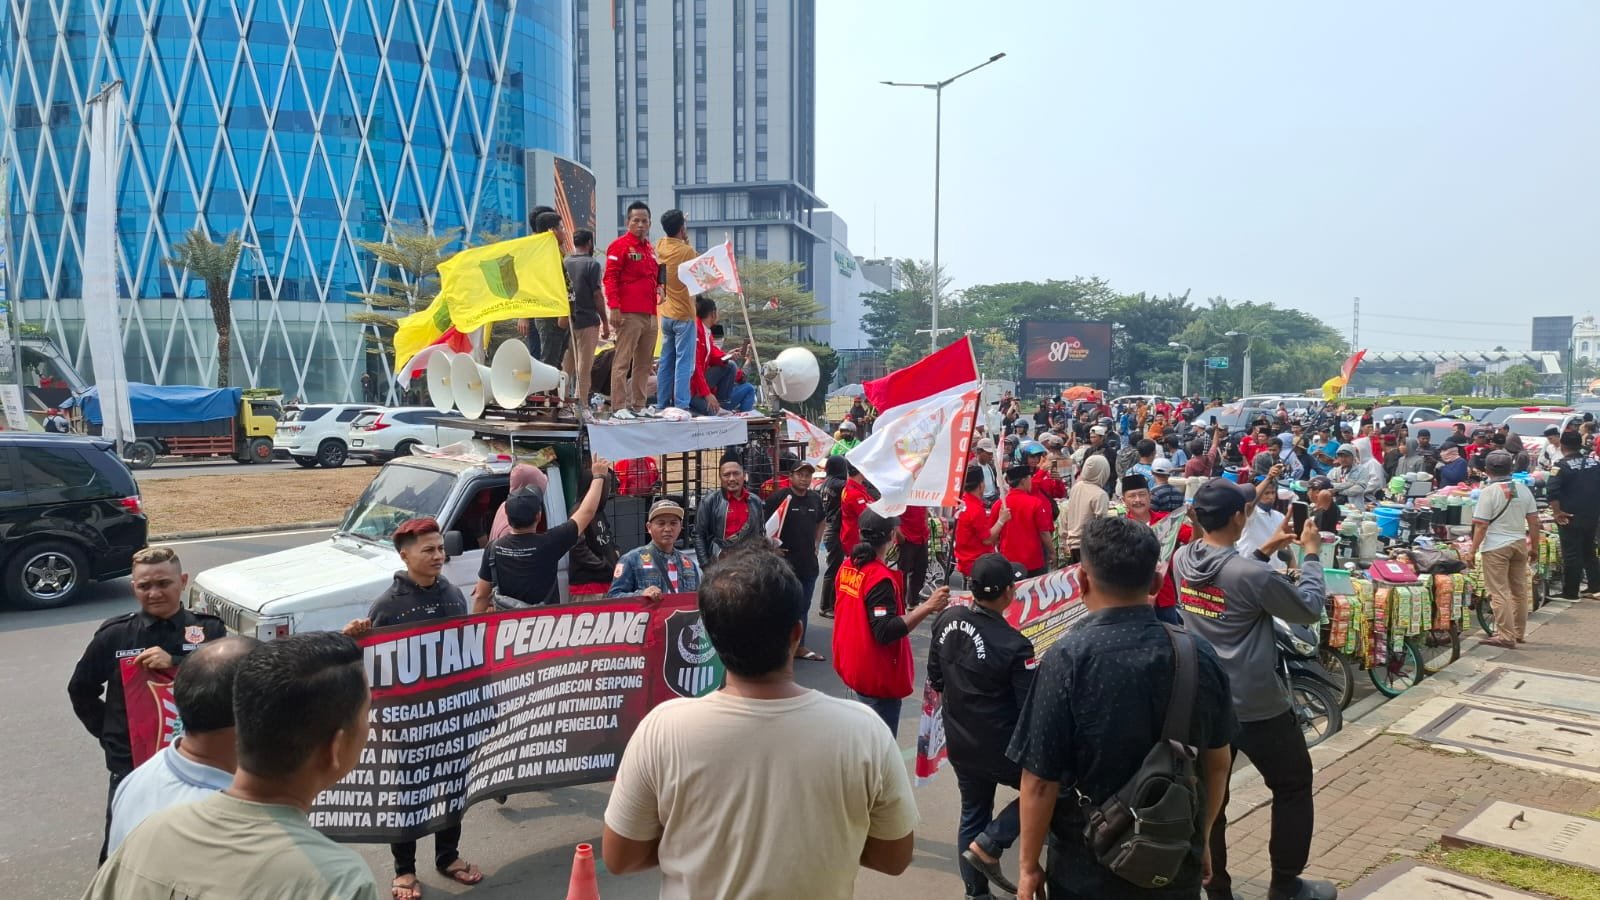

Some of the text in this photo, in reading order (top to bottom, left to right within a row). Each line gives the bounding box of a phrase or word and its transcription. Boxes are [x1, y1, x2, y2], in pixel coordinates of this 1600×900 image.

[495, 611, 650, 661] PEDAGANG
[938, 620, 986, 660] RADAR CNN NEWS
[381, 675, 643, 743] KLARIFIKASI MANAJEMEN SUMMARECON SERPONG
[382, 700, 435, 723] SEGALA
[438, 688, 481, 714] BENTUK
[482, 672, 535, 702] INTIMIDASI
[537, 660, 589, 683] TERHADAP
[591, 656, 646, 673] PEDAGANG
[379, 766, 430, 786] DIALOG
[432, 749, 477, 779] ANTARA
[477, 726, 527, 760] PEDAGANG
[529, 721, 552, 742] DAN
[554, 714, 618, 735] PENGELOLA
[381, 736, 464, 765] INVESTIGASI
[467, 722, 507, 750] DUGAAN
[509, 702, 555, 731] TINDAKAN
[557, 695, 624, 715] INTIMIDATIF
[377, 801, 447, 829] PENATAAN
[490, 767, 515, 785] ADIL
[517, 760, 543, 780] DAN
[545, 753, 616, 775] MANUSIAWI
[378, 779, 463, 807] PEMERINTAH
[519, 738, 568, 760] MEDIASI
